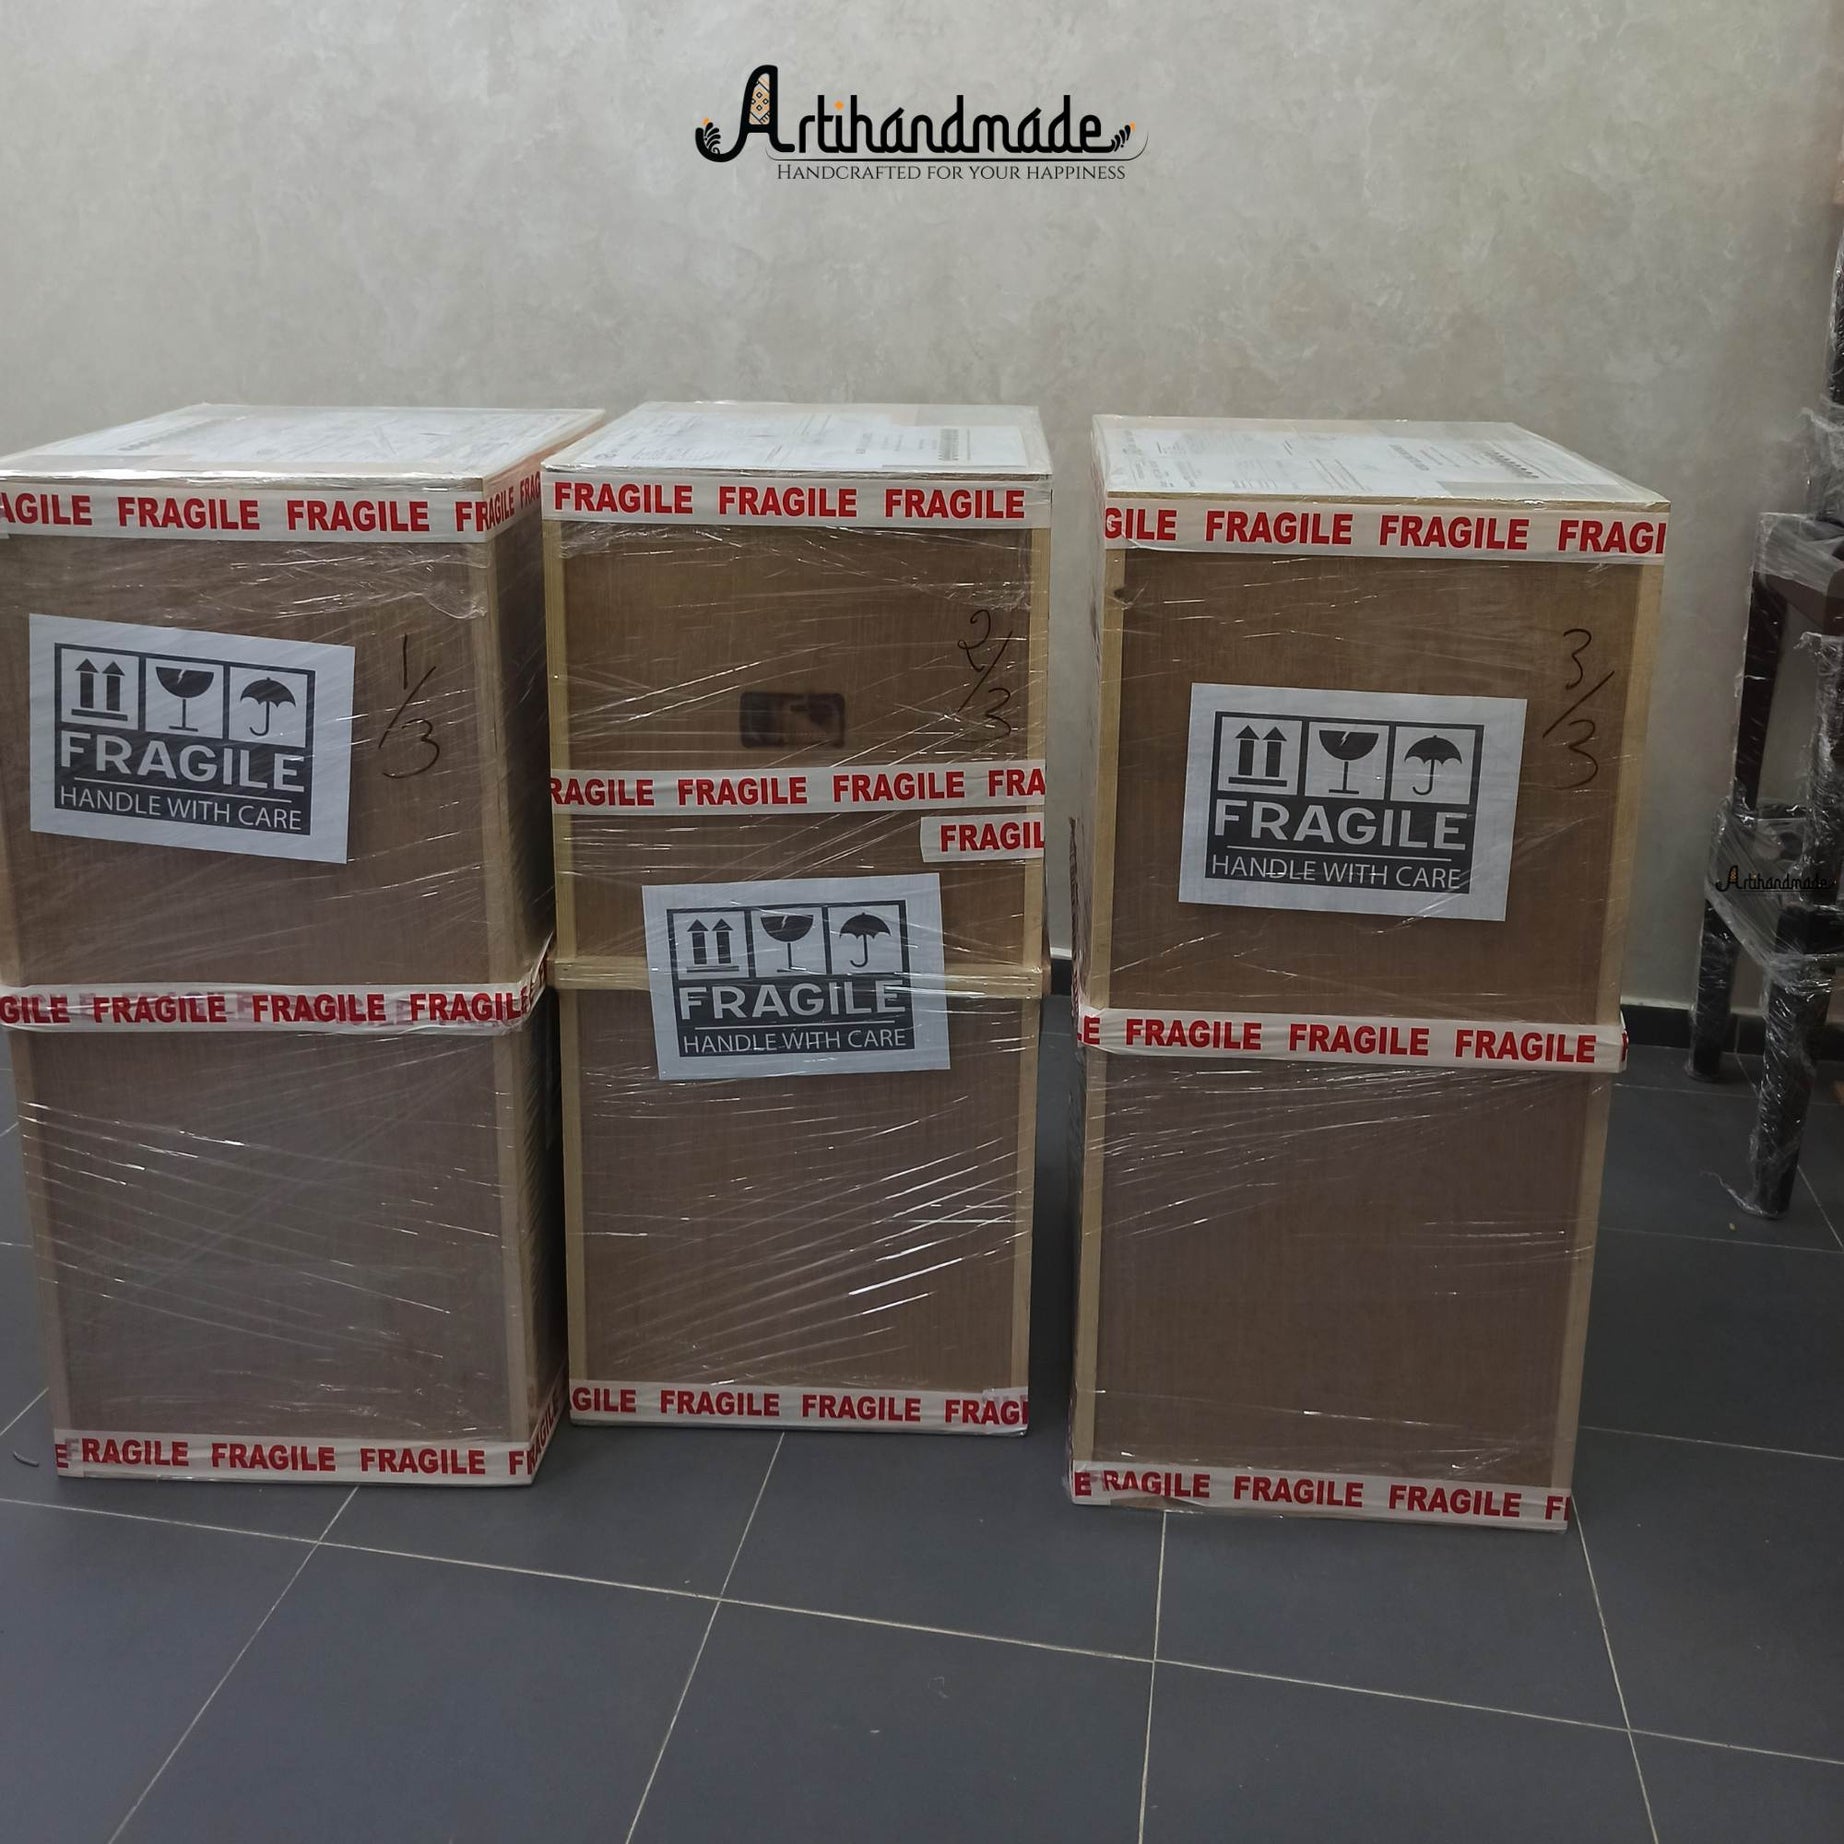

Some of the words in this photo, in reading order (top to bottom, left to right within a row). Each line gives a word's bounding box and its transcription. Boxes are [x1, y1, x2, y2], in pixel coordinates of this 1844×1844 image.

[117, 496, 260, 530] FRAGILE
[287, 500, 430, 532] FRAGILE
[454, 485, 516, 532] FRAGILE
[554, 481, 693, 514] FRAGILE
[719, 486, 857, 518] FRAGILE
[885, 488, 1025, 519] FRAGILE
[1205, 510, 1354, 545] FRAGILE
[1379, 514, 1530, 551] FRAGILE
[1558, 519, 1667, 554] FRAGI
[60, 729, 305, 793] FRAGILE
[60, 785, 161, 816] HANDLE
[166, 797, 231, 824] WITH
[238, 804, 302, 831] CARE
[677, 776, 807, 806] FRAGILE
[833, 771, 965, 803] FRAGILE
[1213, 797, 1469, 851] FRAGILE
[1211, 853, 1316, 881] HANDLE
[1321, 862, 1388, 886] WITH
[1395, 865, 1461, 889] CARE
[92, 995, 227, 1023] FRAGILE
[251, 993, 386, 1023] FRAGILE
[677, 978, 906, 1021] FRAGILE
[683, 1032, 777, 1054] HANDLE
[777, 1030, 841, 1051] WITH
[848, 1028, 907, 1049] CARE
[1125, 1018, 1262, 1051] FRAGILE
[1289, 1023, 1430, 1057] FRAGILE
[1455, 1029, 1597, 1064] FRAGILE
[660, 1389, 779, 1417] FRAGILE
[802, 1394, 920, 1422] FRAGILE
[211, 1442, 336, 1472] FRAGILE
[360, 1448, 486, 1475] FRAGILE
[1233, 1476, 1364, 1508] FRAGILE
[1389, 1484, 1521, 1518] FRAGILE
